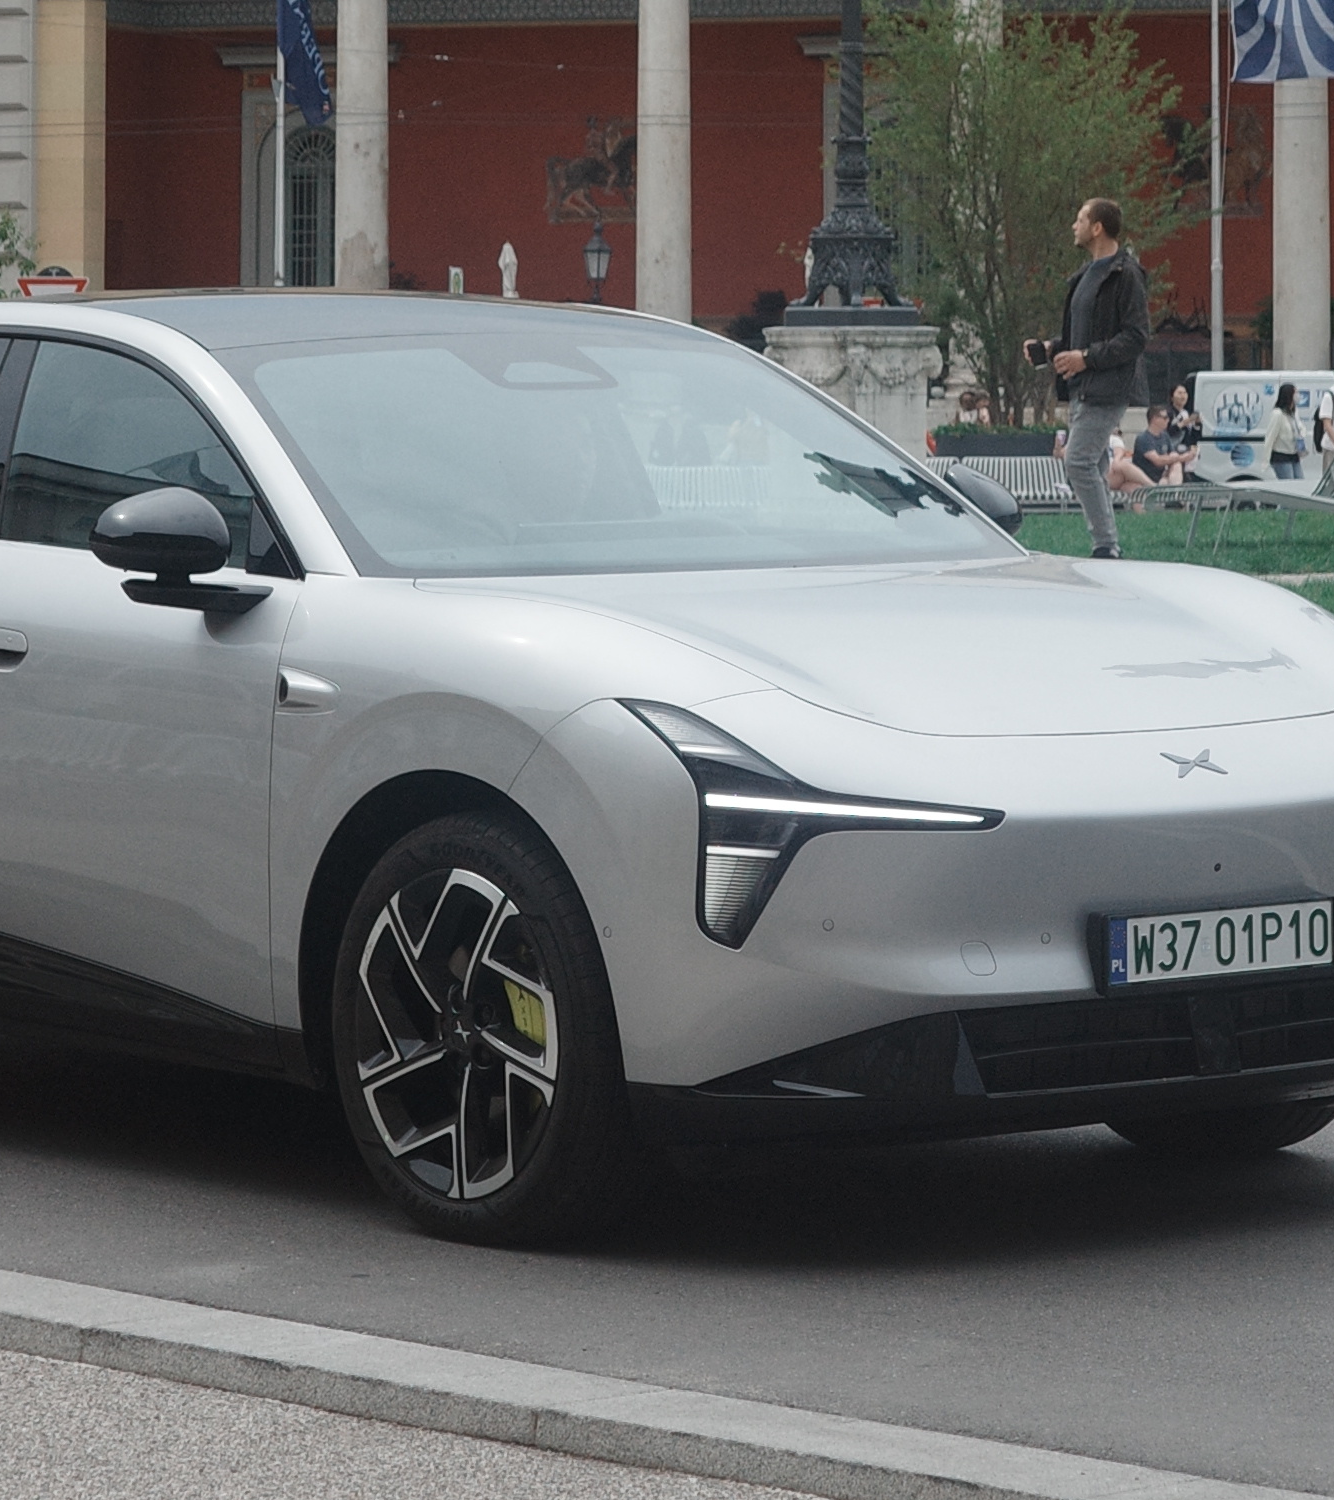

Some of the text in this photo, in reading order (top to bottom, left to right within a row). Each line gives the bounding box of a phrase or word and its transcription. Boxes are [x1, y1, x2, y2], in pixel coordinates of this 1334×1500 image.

[1133, 907, 1329, 975] W37 01P10
[1111, 958, 1126, 973] PL
